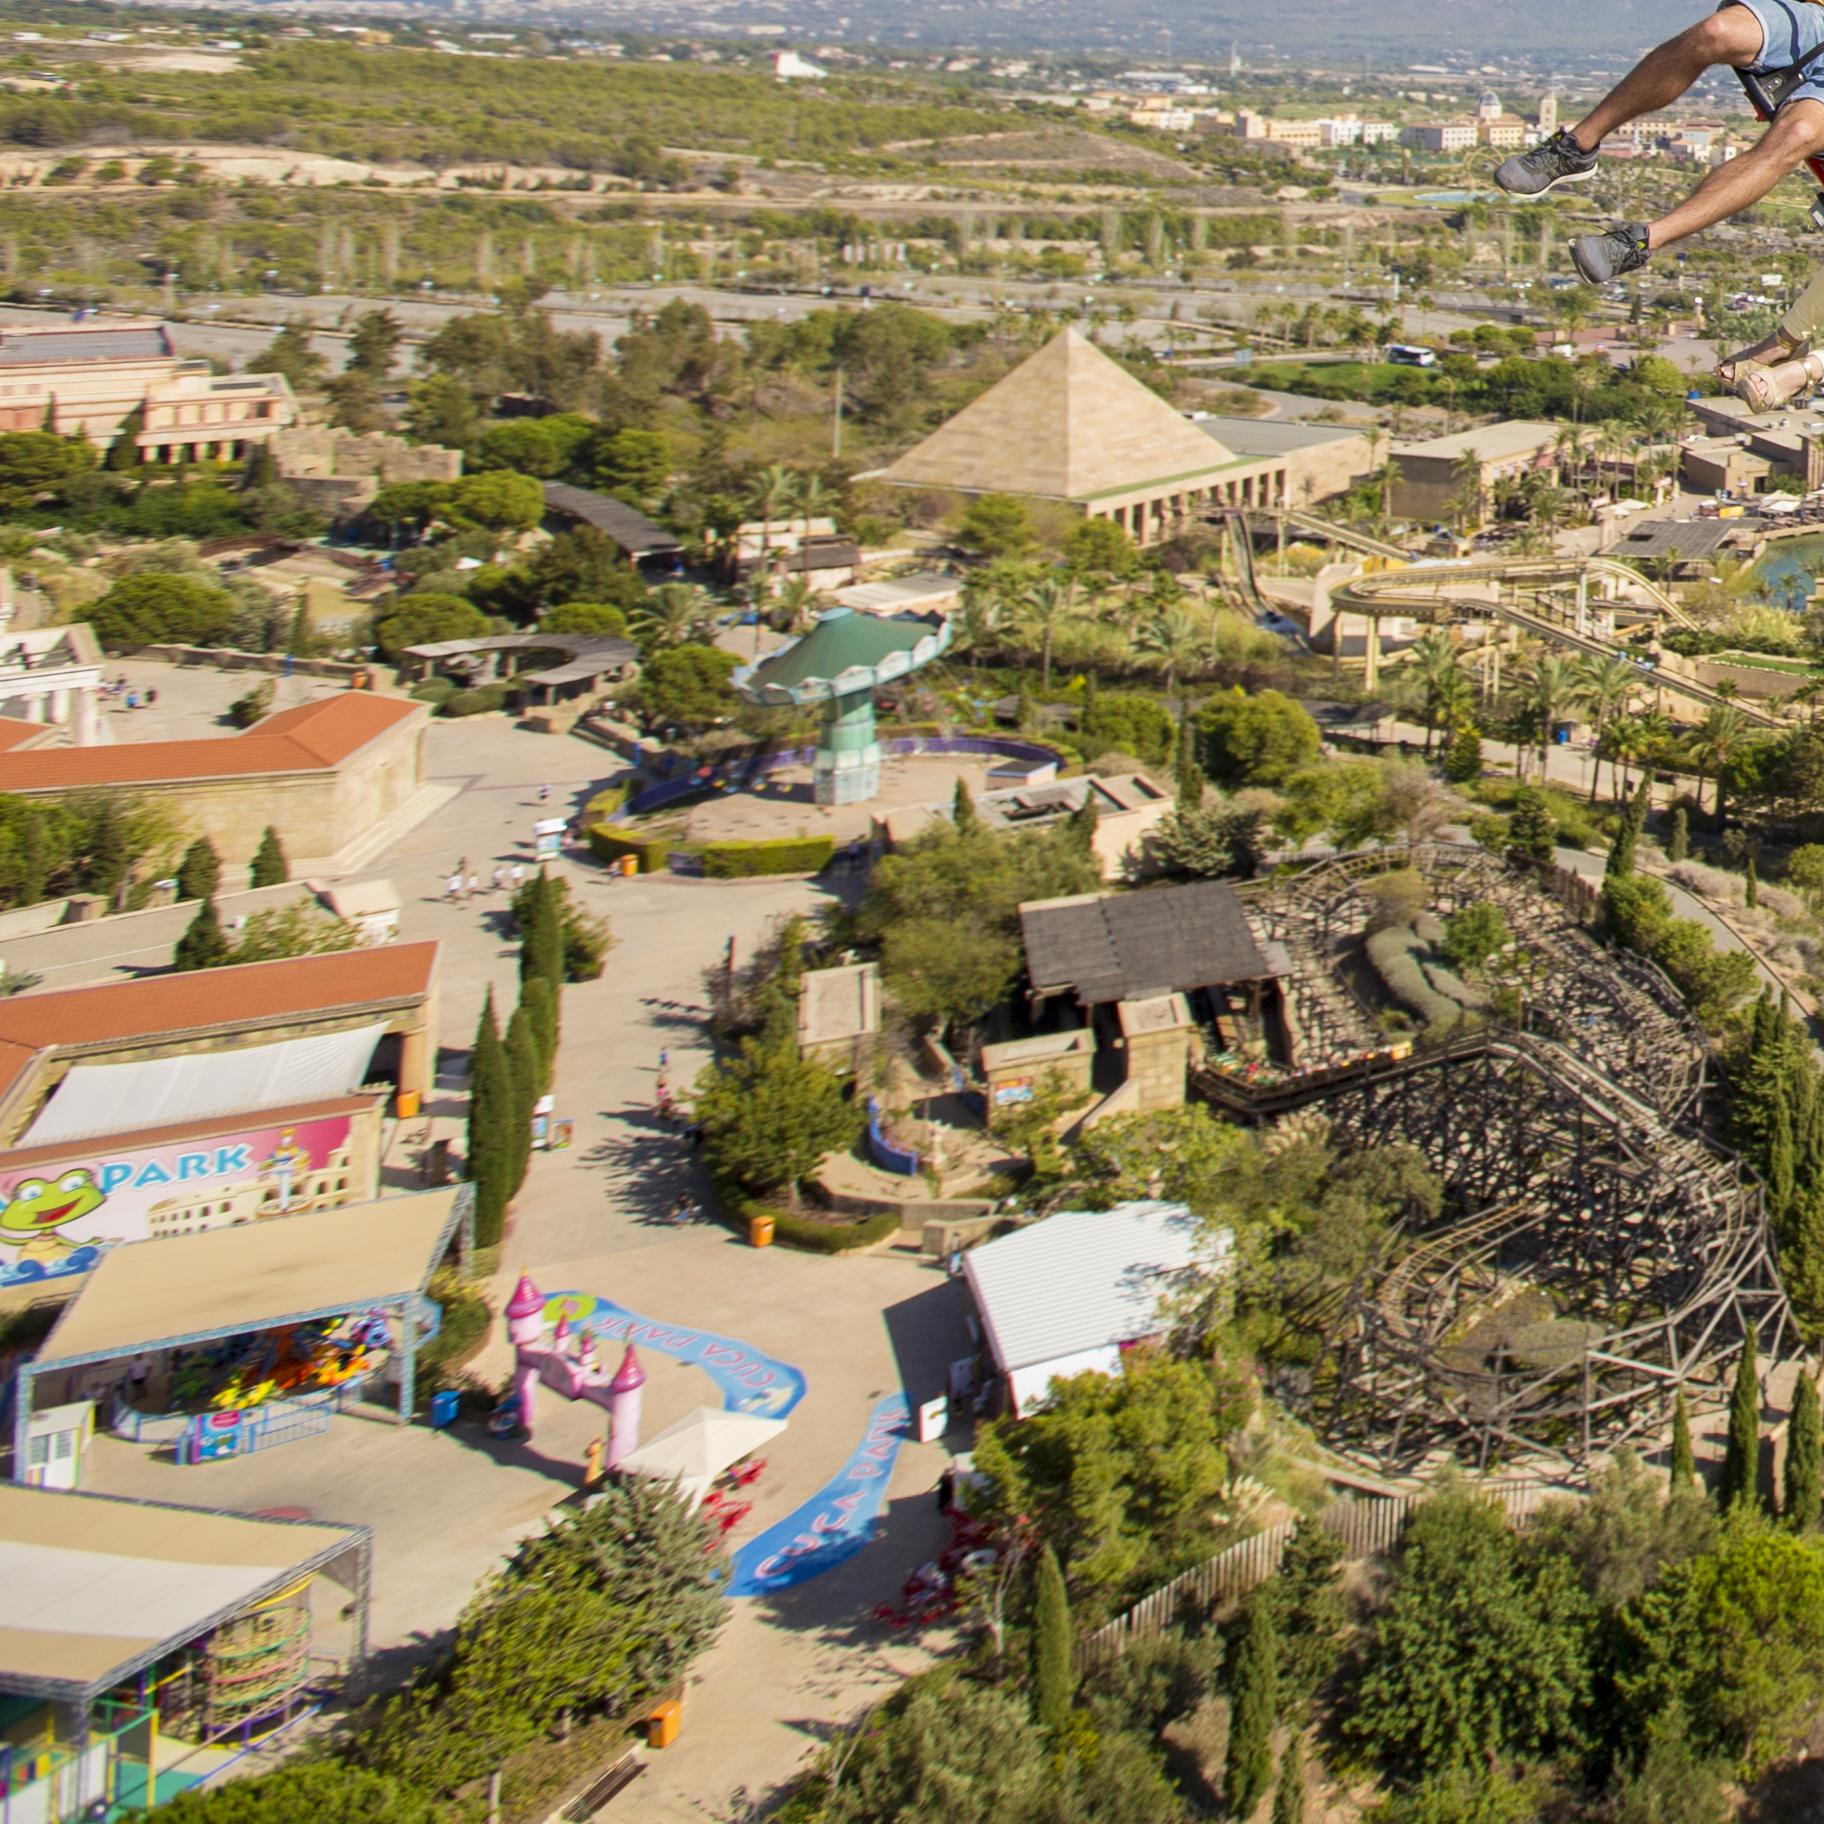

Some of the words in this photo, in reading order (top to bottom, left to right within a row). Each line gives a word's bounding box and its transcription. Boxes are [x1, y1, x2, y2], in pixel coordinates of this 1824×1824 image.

[99, 1142, 253, 1196] PARK
[702, 1342, 775, 1388] CUCA
[753, 1490, 868, 1578] CUCA
